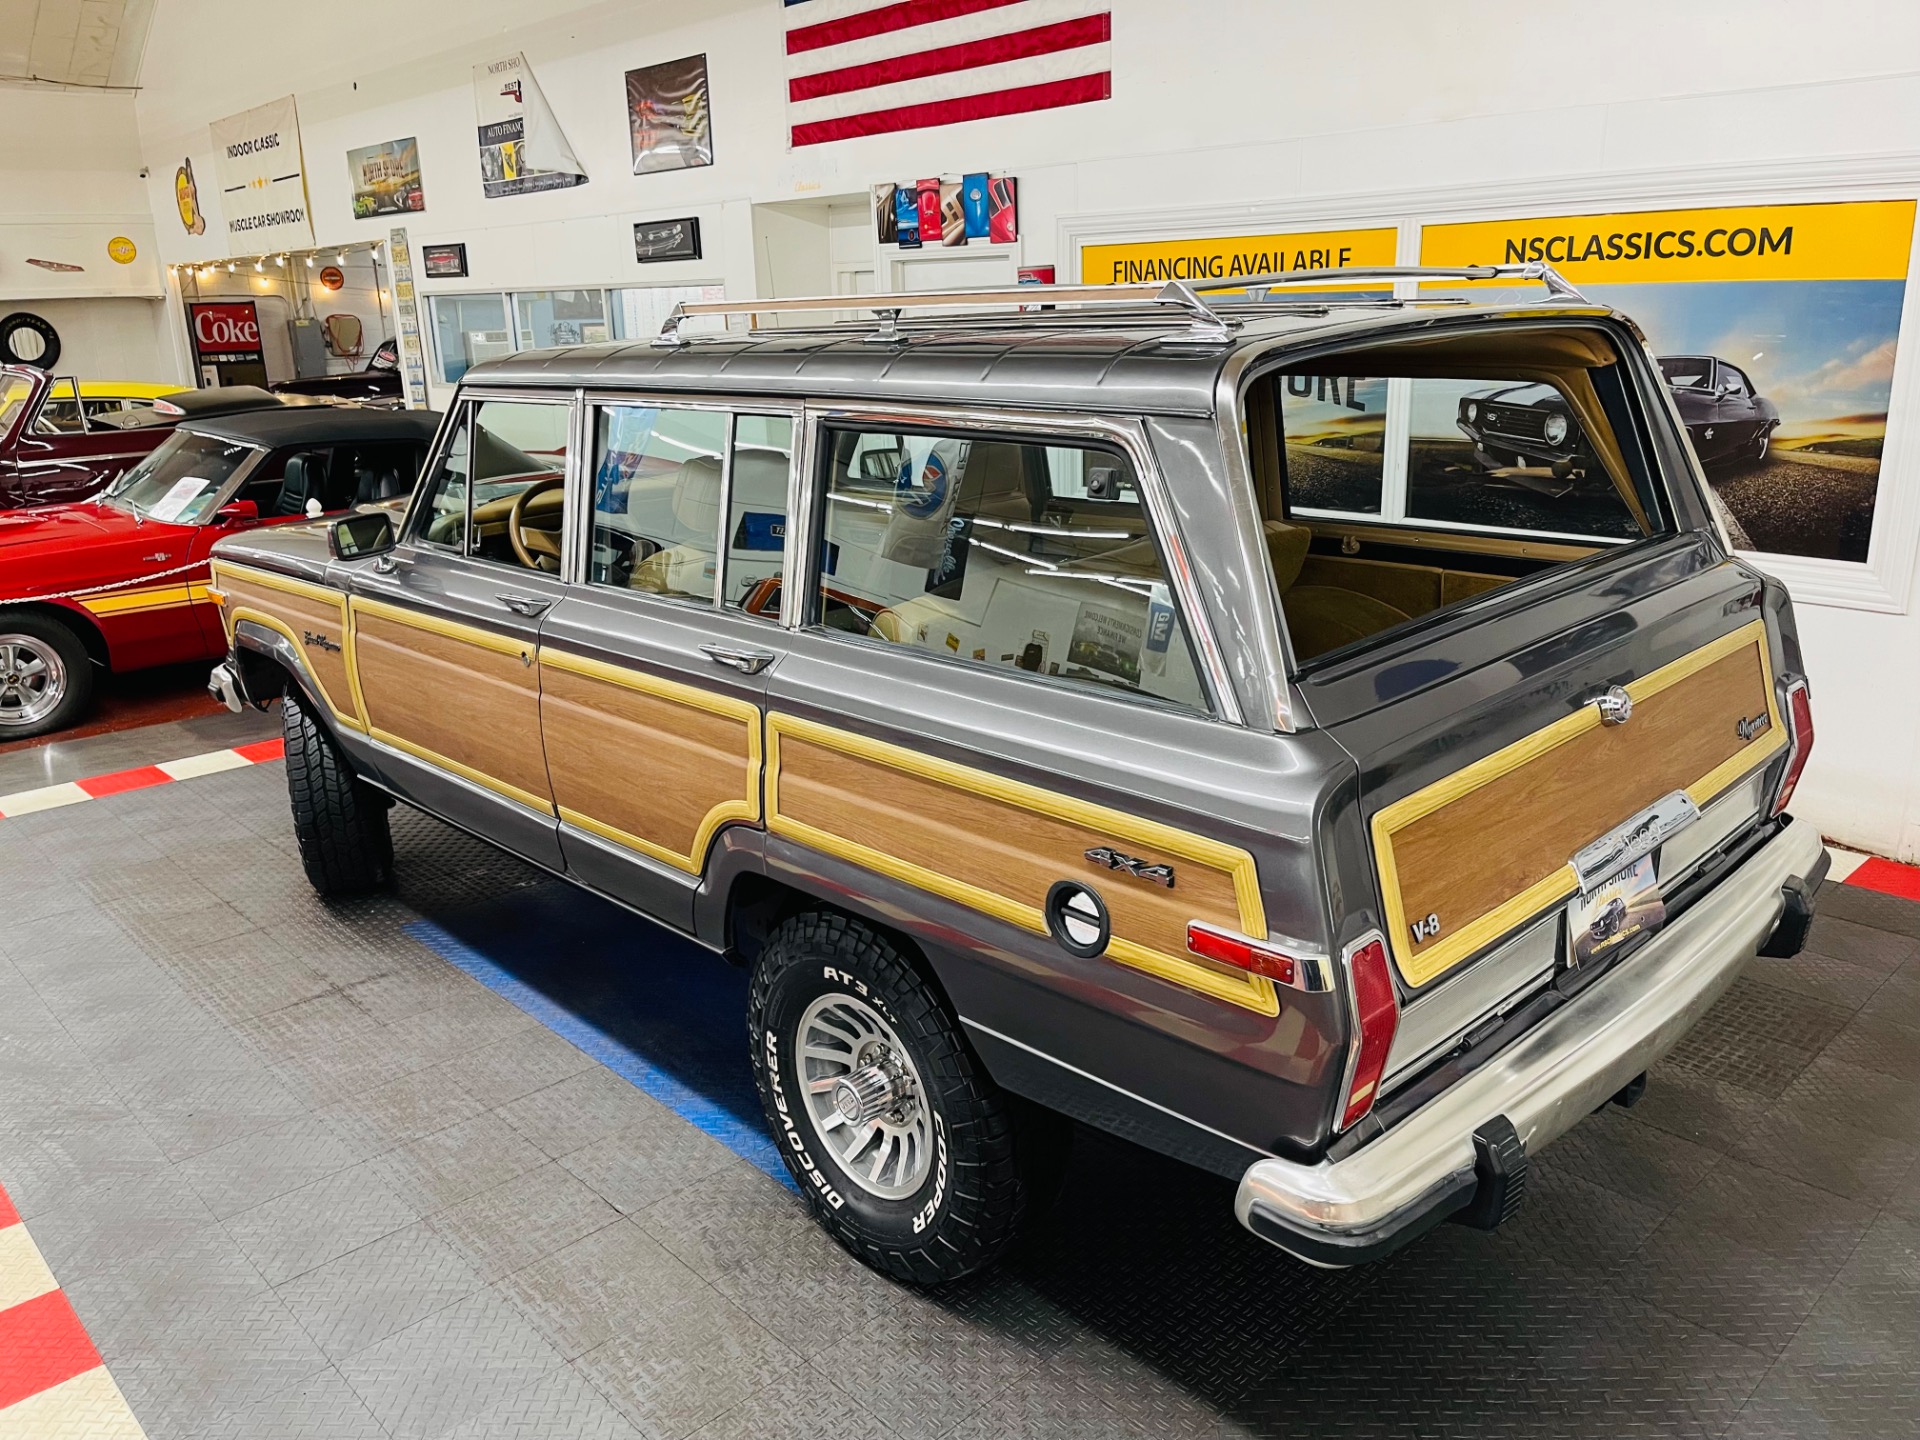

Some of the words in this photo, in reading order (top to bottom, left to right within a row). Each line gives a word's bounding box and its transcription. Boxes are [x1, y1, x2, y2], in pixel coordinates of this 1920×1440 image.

[504, 81, 517, 91] BEST
[487, 124, 503, 138] AUTO
[226, 140, 253, 159] INDOOR
[253, 132, 280, 153] CLASSIC
[229, 216, 252, 234] MUSCLE
[253, 214, 266, 229] CAR
[266, 207, 305, 227] SHOWROOM
[1505, 227, 1793, 264] NSCLASSICS.COM
[1113, 255, 1223, 283] FINANCING
[195, 312, 259, 343] Coke
[1156, 612, 1170, 641] GM
[1410, 913, 1440, 944] V-8
[872, 996, 898, 1024] XLT
[766, 1030, 845, 1210] DISCOVERER
[912, 1110, 948, 1234] COOPER
